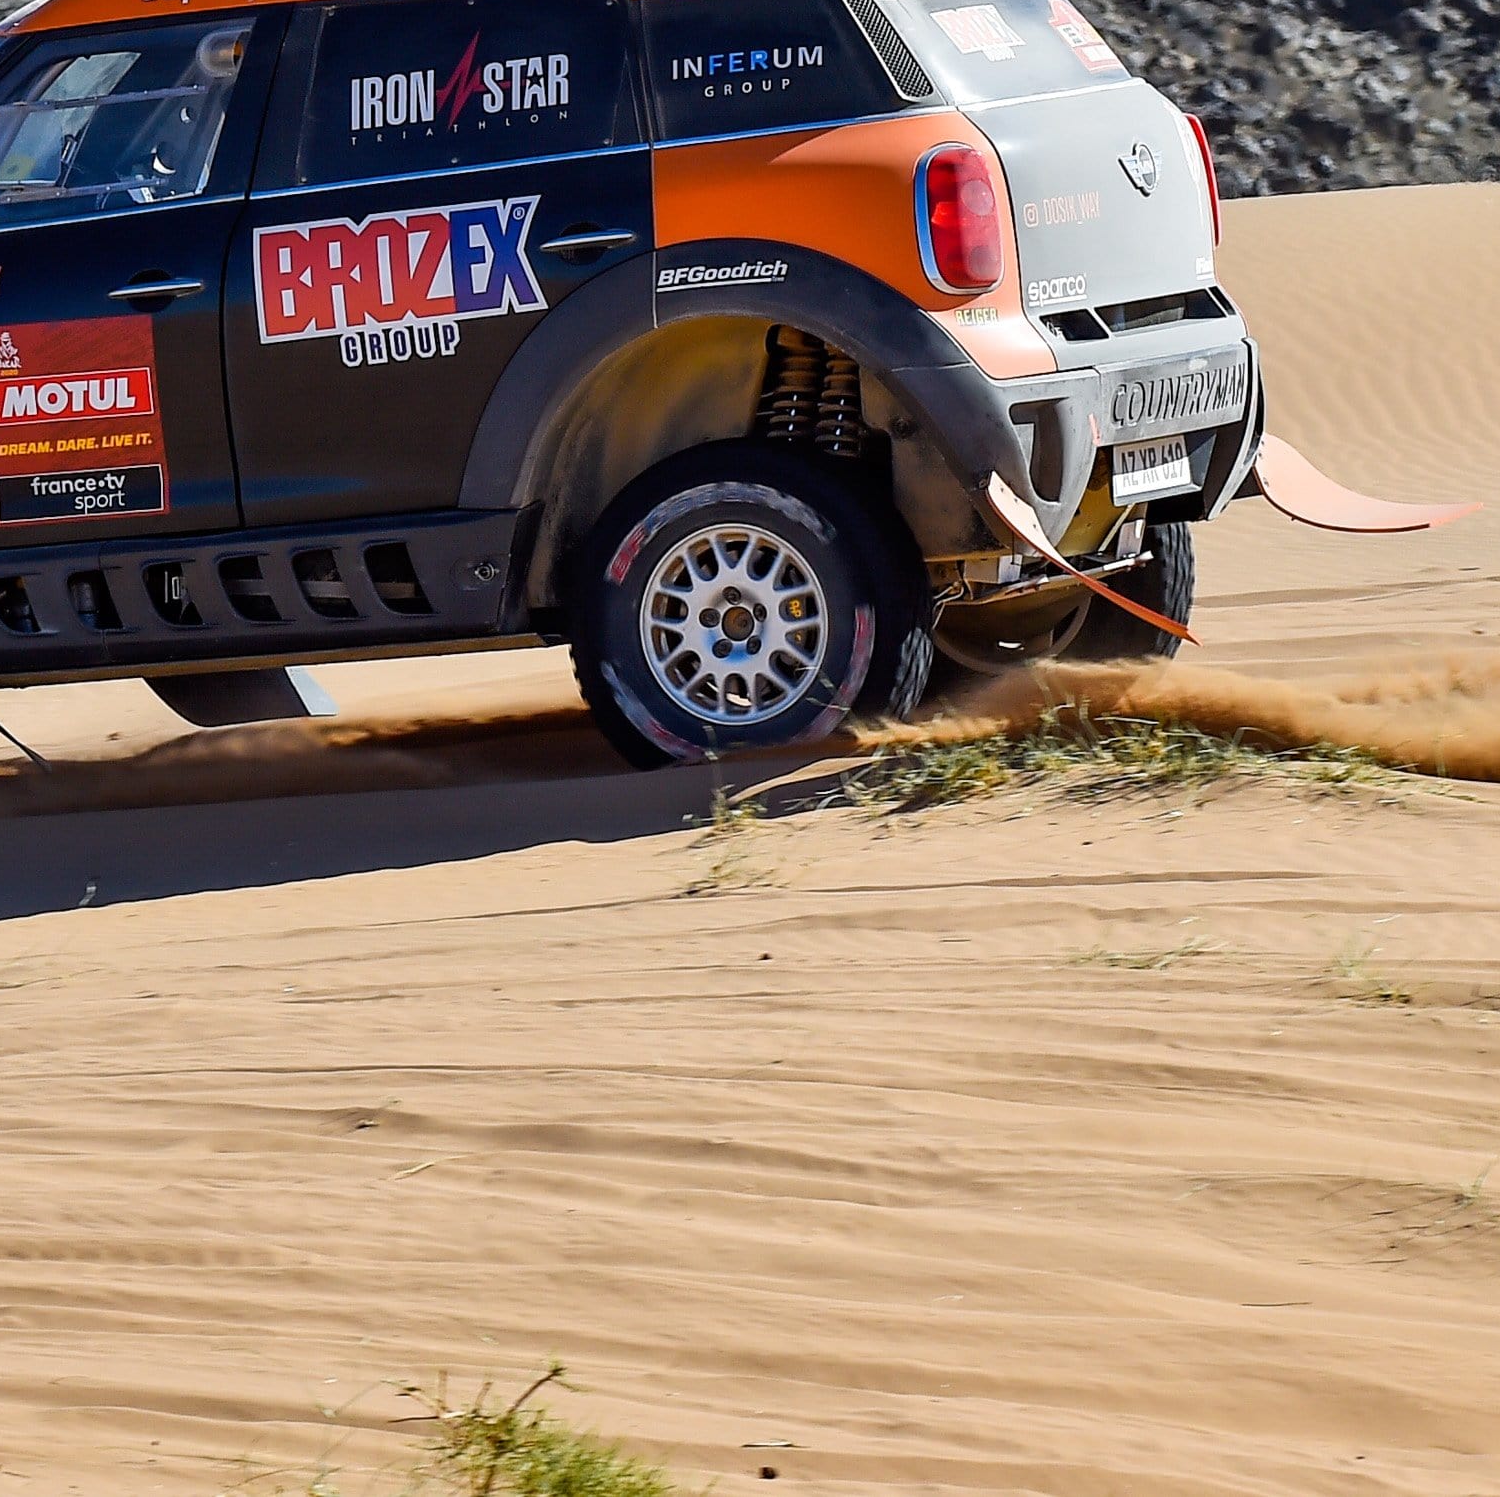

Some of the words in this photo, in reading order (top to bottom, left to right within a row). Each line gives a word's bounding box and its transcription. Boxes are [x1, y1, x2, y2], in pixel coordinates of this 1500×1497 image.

[672, 45, 823, 80] INFERUM
[351, 69, 435, 131] IRON
[482, 53, 569, 114] STAR
[704, 78, 791, 98] GROUP
[351, 110, 568, 146] TRIATHLON
[255, 198, 544, 341] BROZEX
[657, 259, 789, 287] BFGoodrich
[1027, 275, 1087, 307] sparco
[341, 321, 459, 366] GROUP
[1, 377, 137, 419] MOTUL
[1110, 362, 1247, 429] COUNTRYMAN
[56, 437, 99, 453] DARE.
[102, 434, 134, 449] LIVE
[135, 432, 153, 446] IT.
[74, 491, 126, 516] sport
